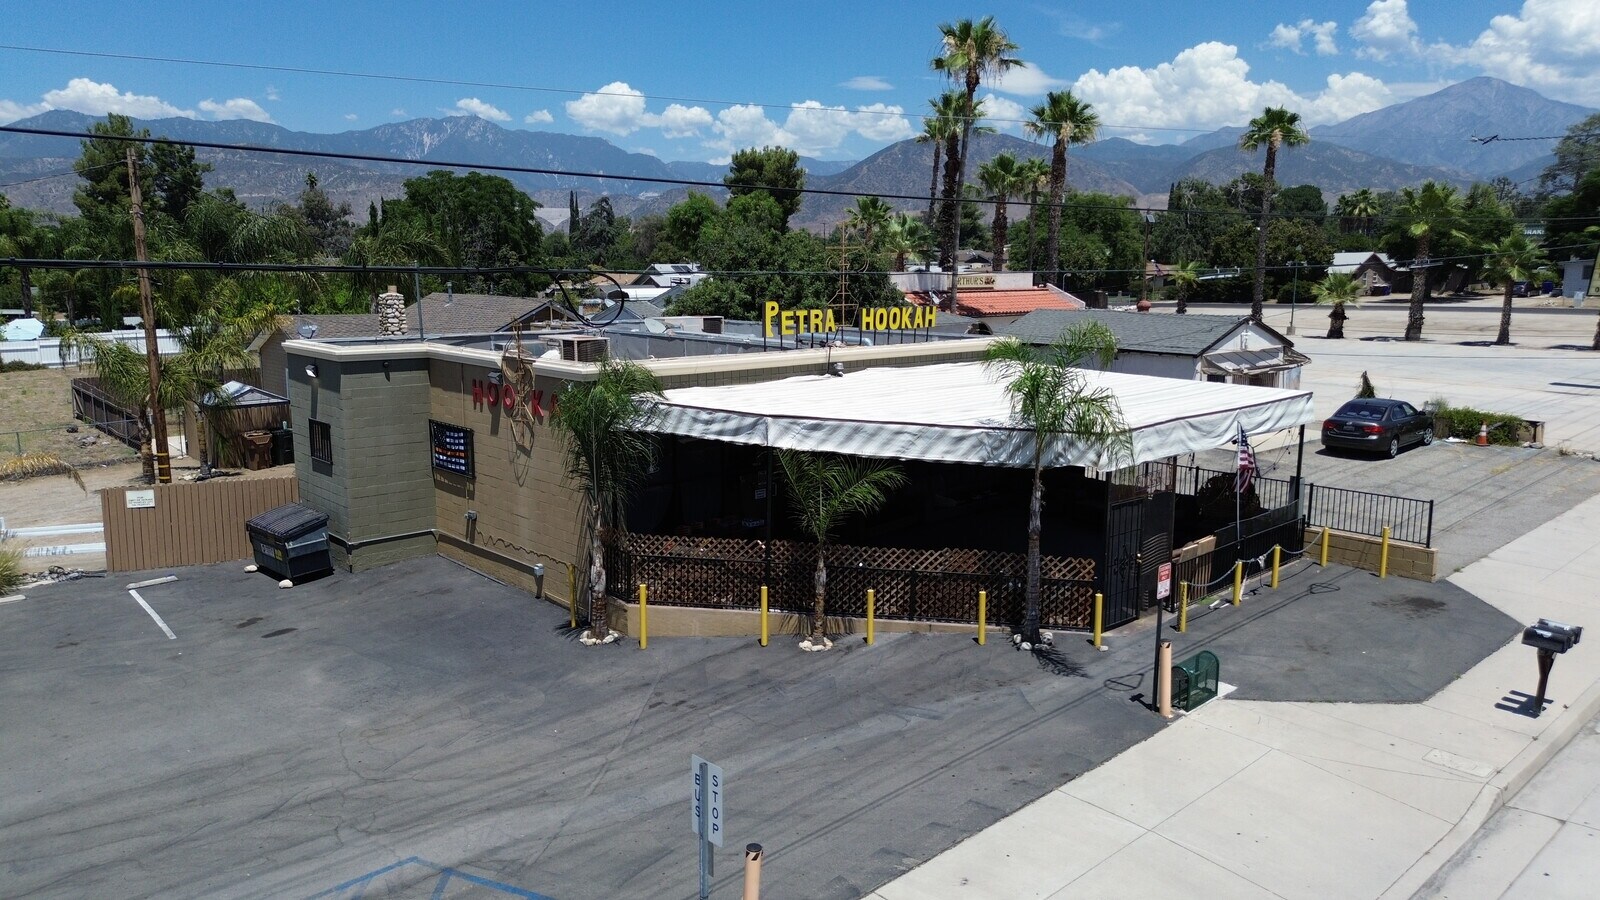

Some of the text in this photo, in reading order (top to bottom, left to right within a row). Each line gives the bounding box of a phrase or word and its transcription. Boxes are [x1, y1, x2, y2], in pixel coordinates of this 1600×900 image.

[957, 276, 984, 286] RTHUR'S
[764, 301, 937, 338] PETRA HOOKAH
